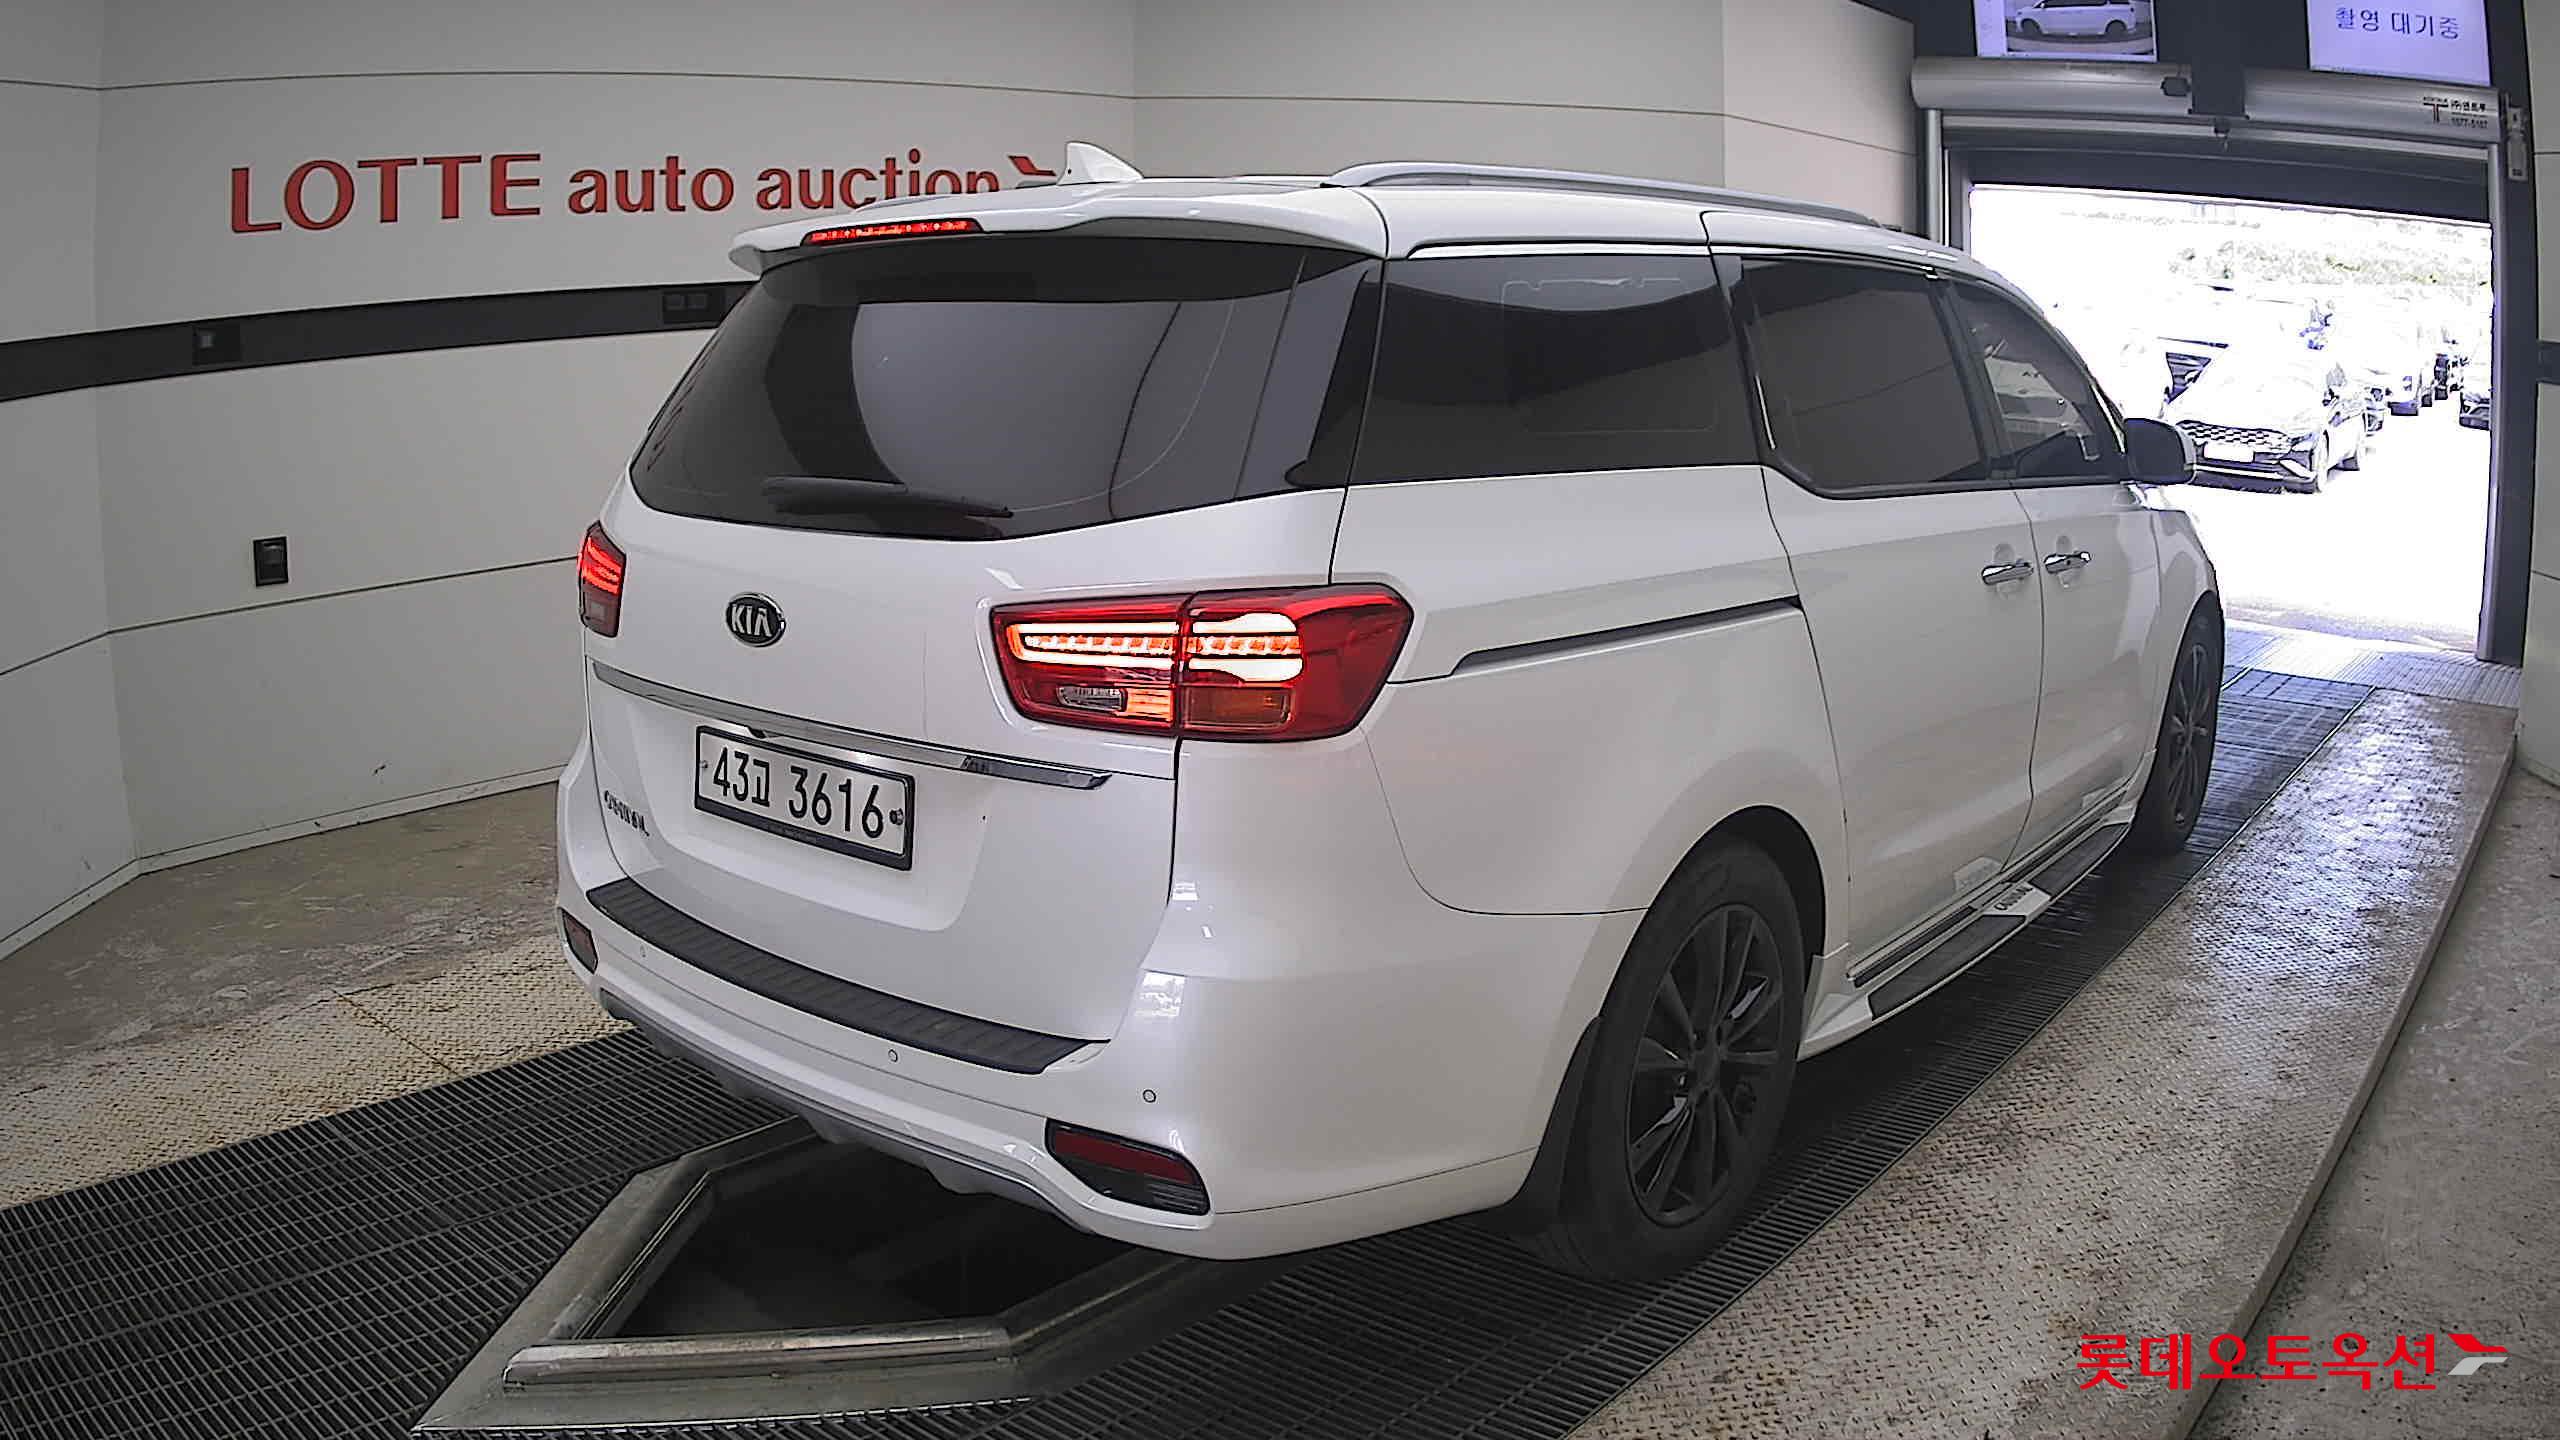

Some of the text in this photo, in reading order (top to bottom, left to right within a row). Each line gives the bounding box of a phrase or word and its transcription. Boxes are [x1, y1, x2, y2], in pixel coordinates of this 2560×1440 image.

[2391, 12, 2460, 40] 대기중
[231, 147, 1000, 233] LOTTE auto auction
[731, 603, 773, 637] KIA
[713, 746, 884, 839] 43고 3616
